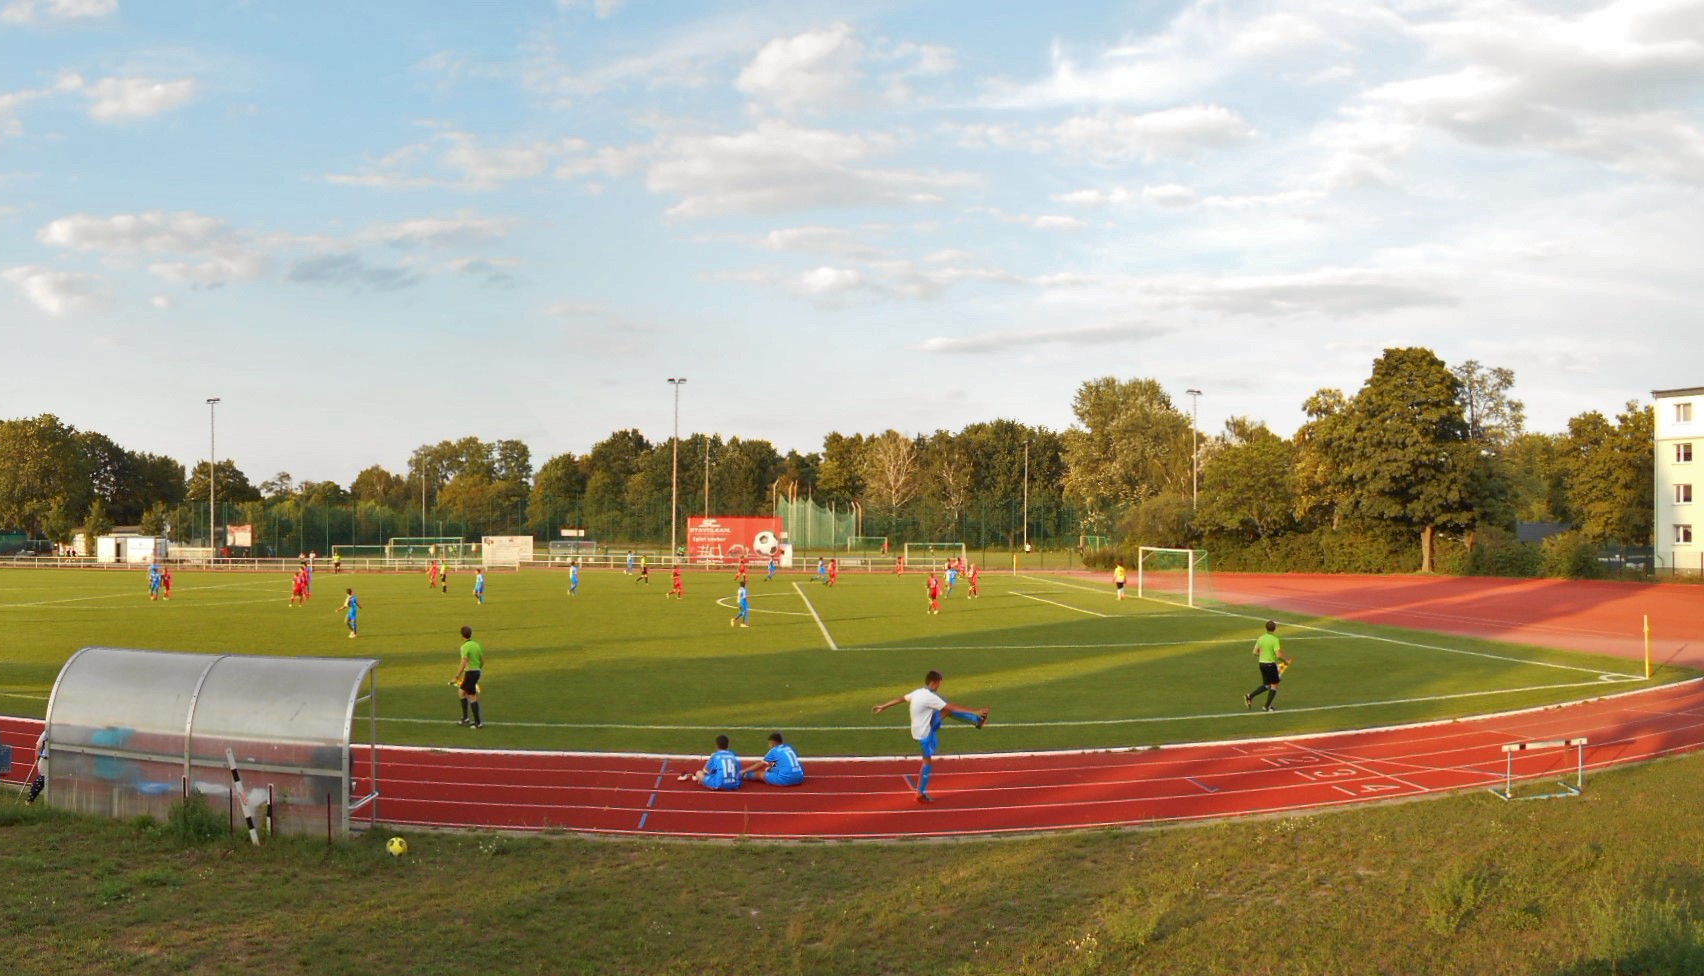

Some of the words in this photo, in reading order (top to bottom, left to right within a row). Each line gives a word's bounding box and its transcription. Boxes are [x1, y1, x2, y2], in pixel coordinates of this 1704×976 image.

[1277, 756, 1321, 764] 2
[721, 758, 736, 778] 14
[1314, 768, 1357, 777] 3
[1361, 784, 1401, 793] 4
